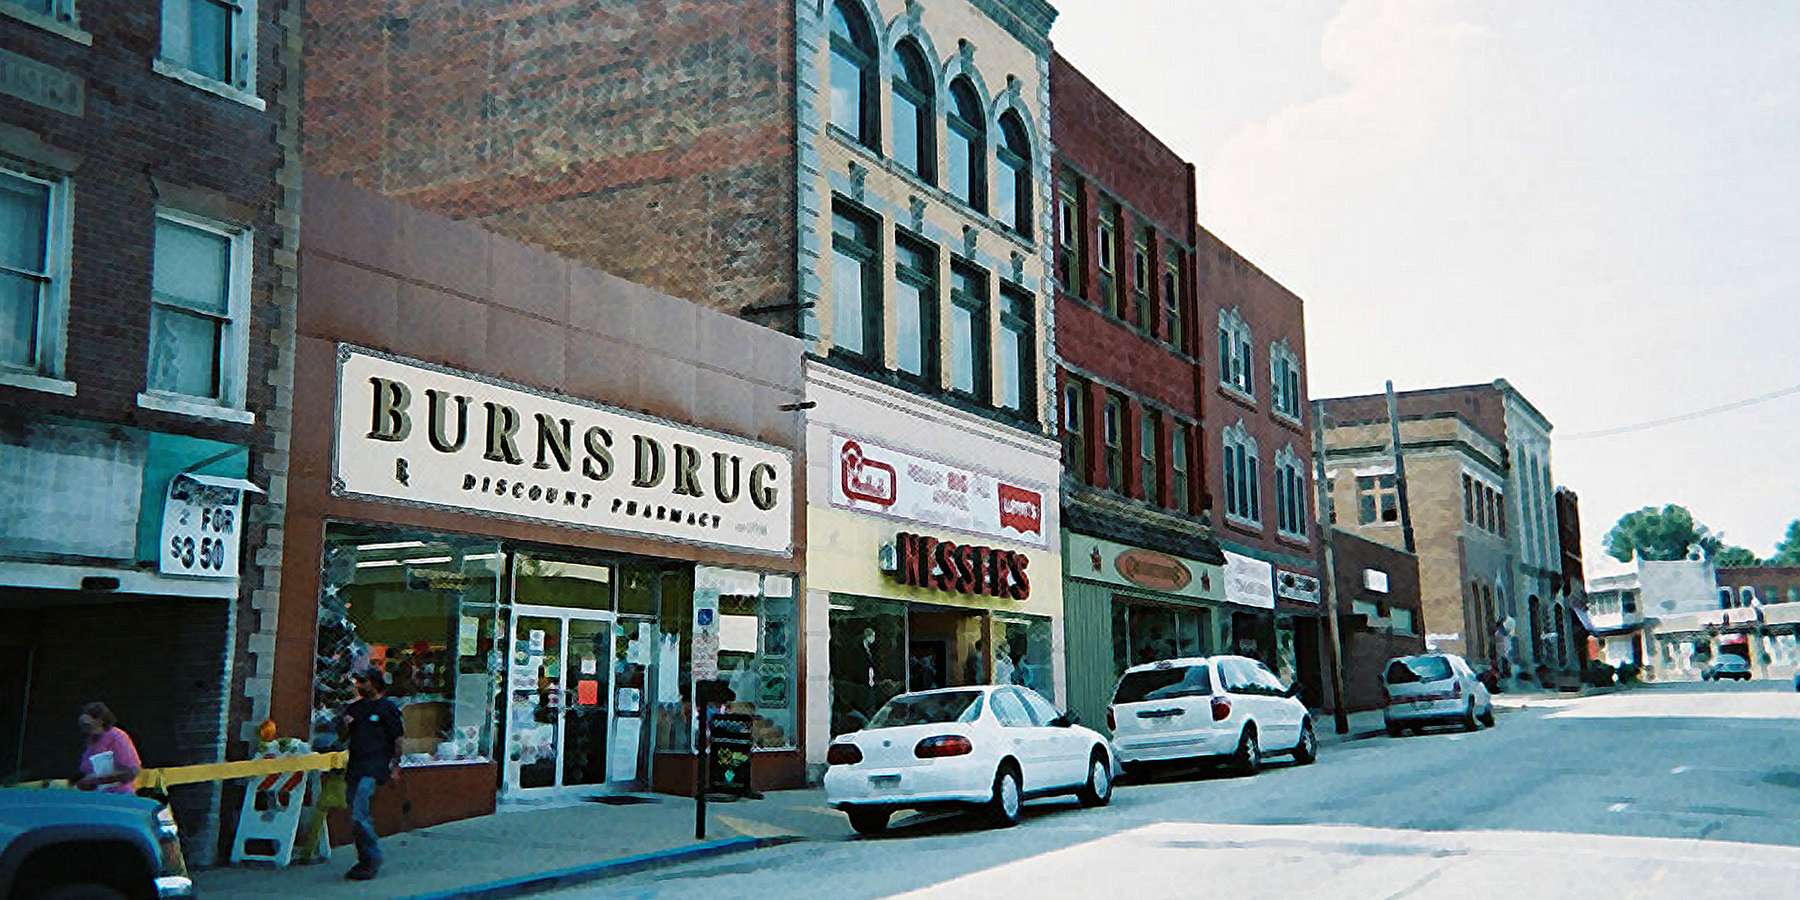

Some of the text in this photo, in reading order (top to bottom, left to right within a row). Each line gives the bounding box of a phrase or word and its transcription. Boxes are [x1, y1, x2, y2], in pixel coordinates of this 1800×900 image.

[366, 376, 779, 511] BURNS DRUG
[201, 507, 235, 534] FOR
[462, 474, 592, 509] DISCOUNT
[611, 498, 722, 529] PHARMACY
